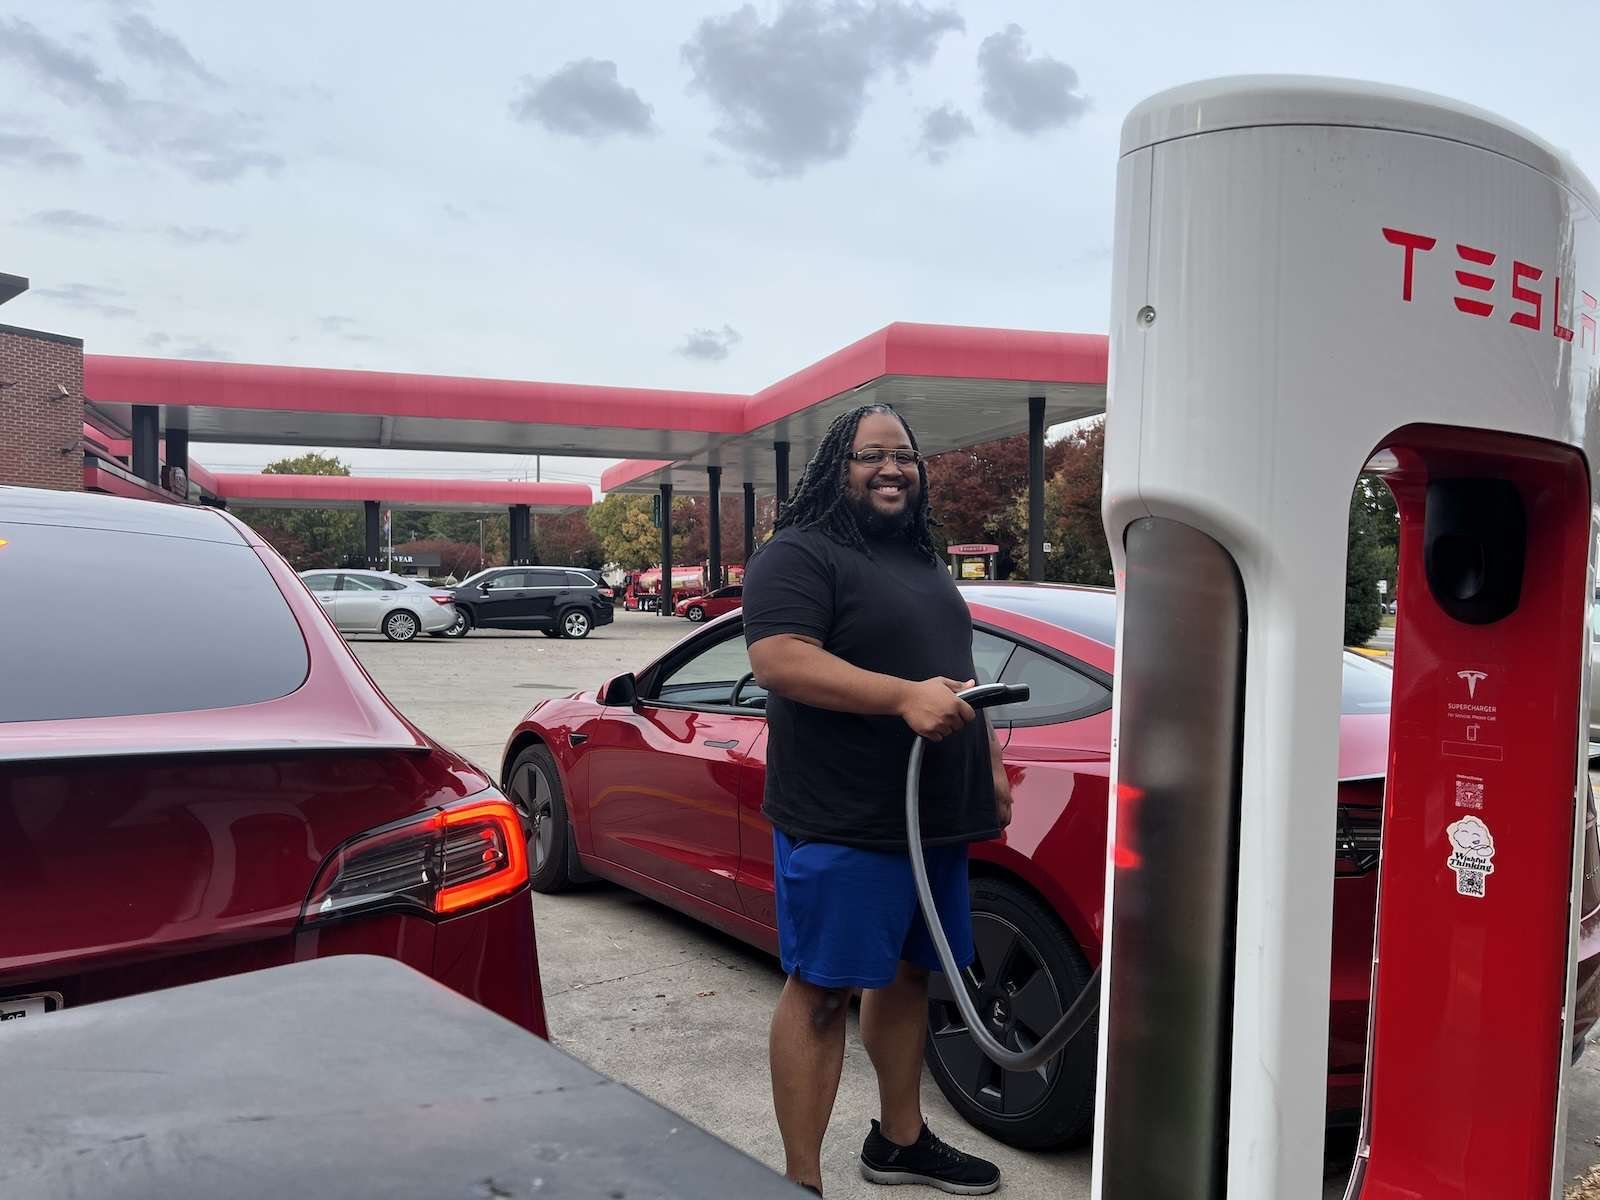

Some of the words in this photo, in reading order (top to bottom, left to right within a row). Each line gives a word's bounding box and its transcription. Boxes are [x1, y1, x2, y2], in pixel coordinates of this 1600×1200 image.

[1381, 227, 1598, 356] TESLA
[1447, 703, 1497, 713] SUPERCHARGER
[1455, 852, 1486, 864] Wishful
[1449, 858, 1492, 871] Thinking
